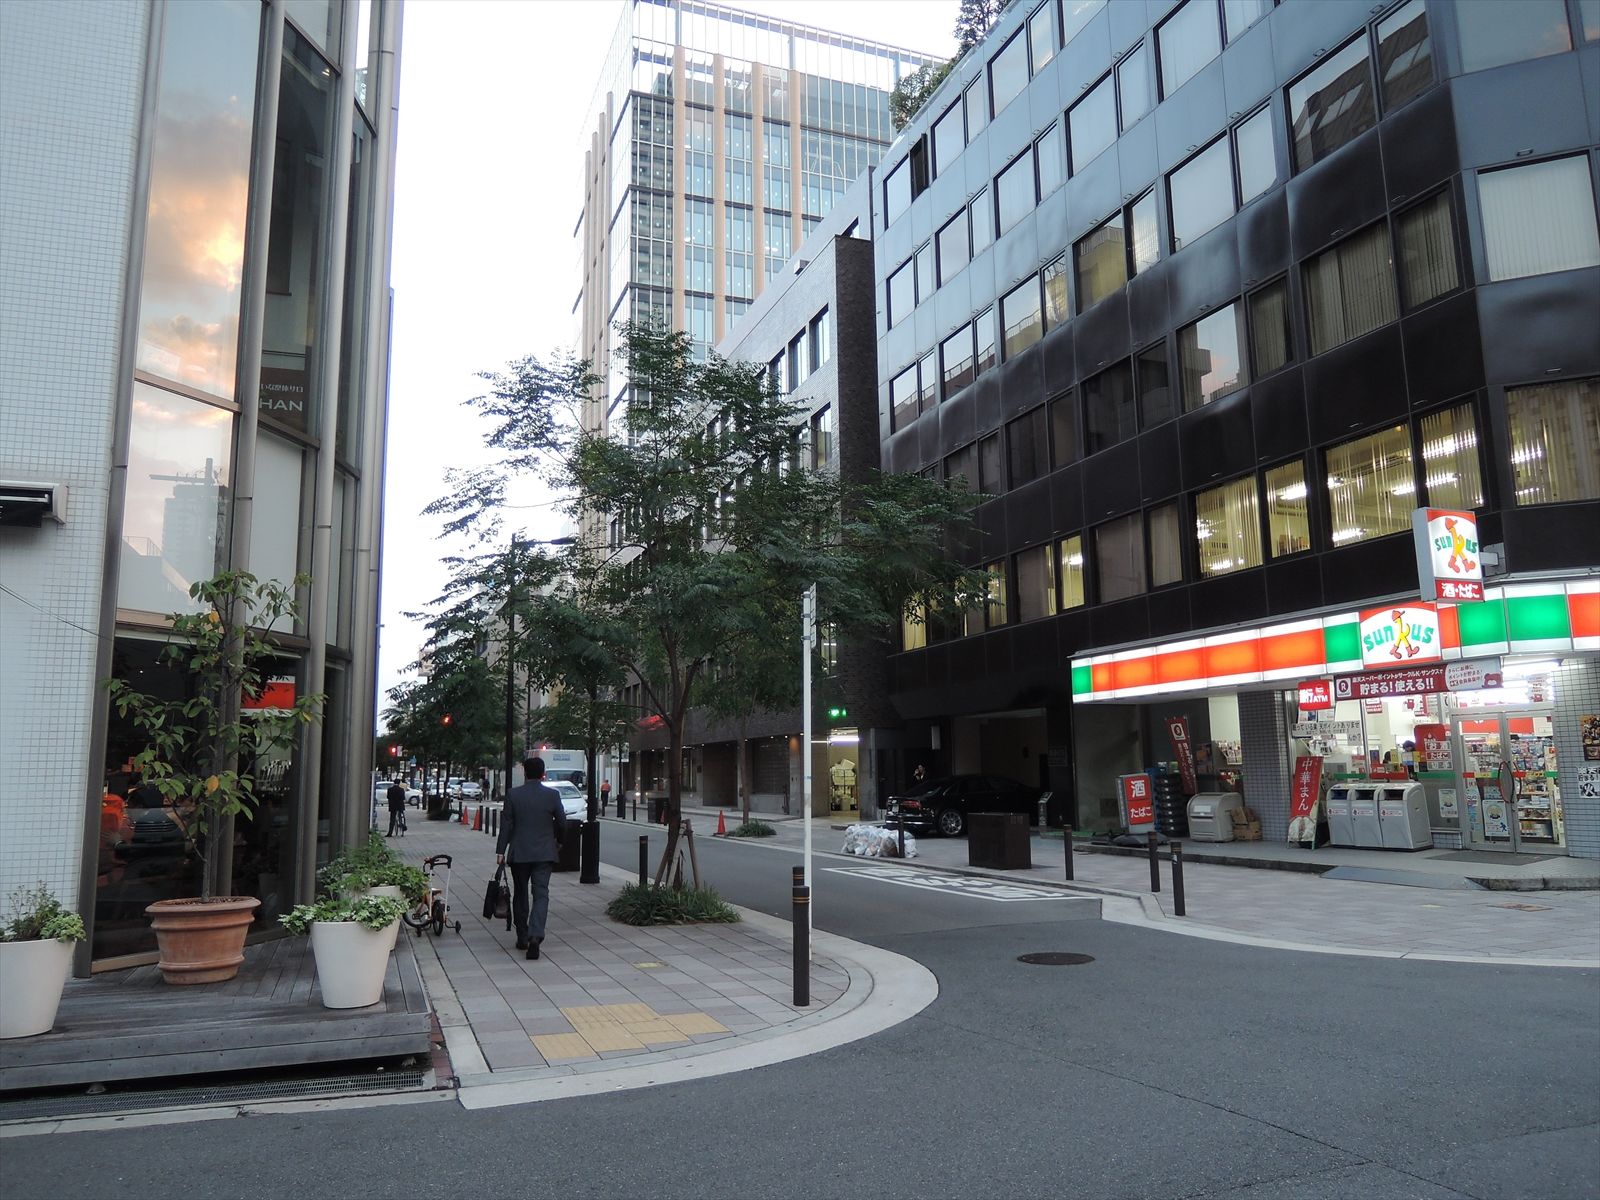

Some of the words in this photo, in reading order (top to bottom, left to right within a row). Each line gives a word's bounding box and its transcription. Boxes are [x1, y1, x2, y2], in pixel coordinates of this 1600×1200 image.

[259, 398, 303, 412] HAN
[1313, 694, 1328, 703] ATM
[1130, 779, 1146, 798] 酒
[1298, 757, 1313, 811] 中華まん
[1130, 806, 1153, 818] たばこ
